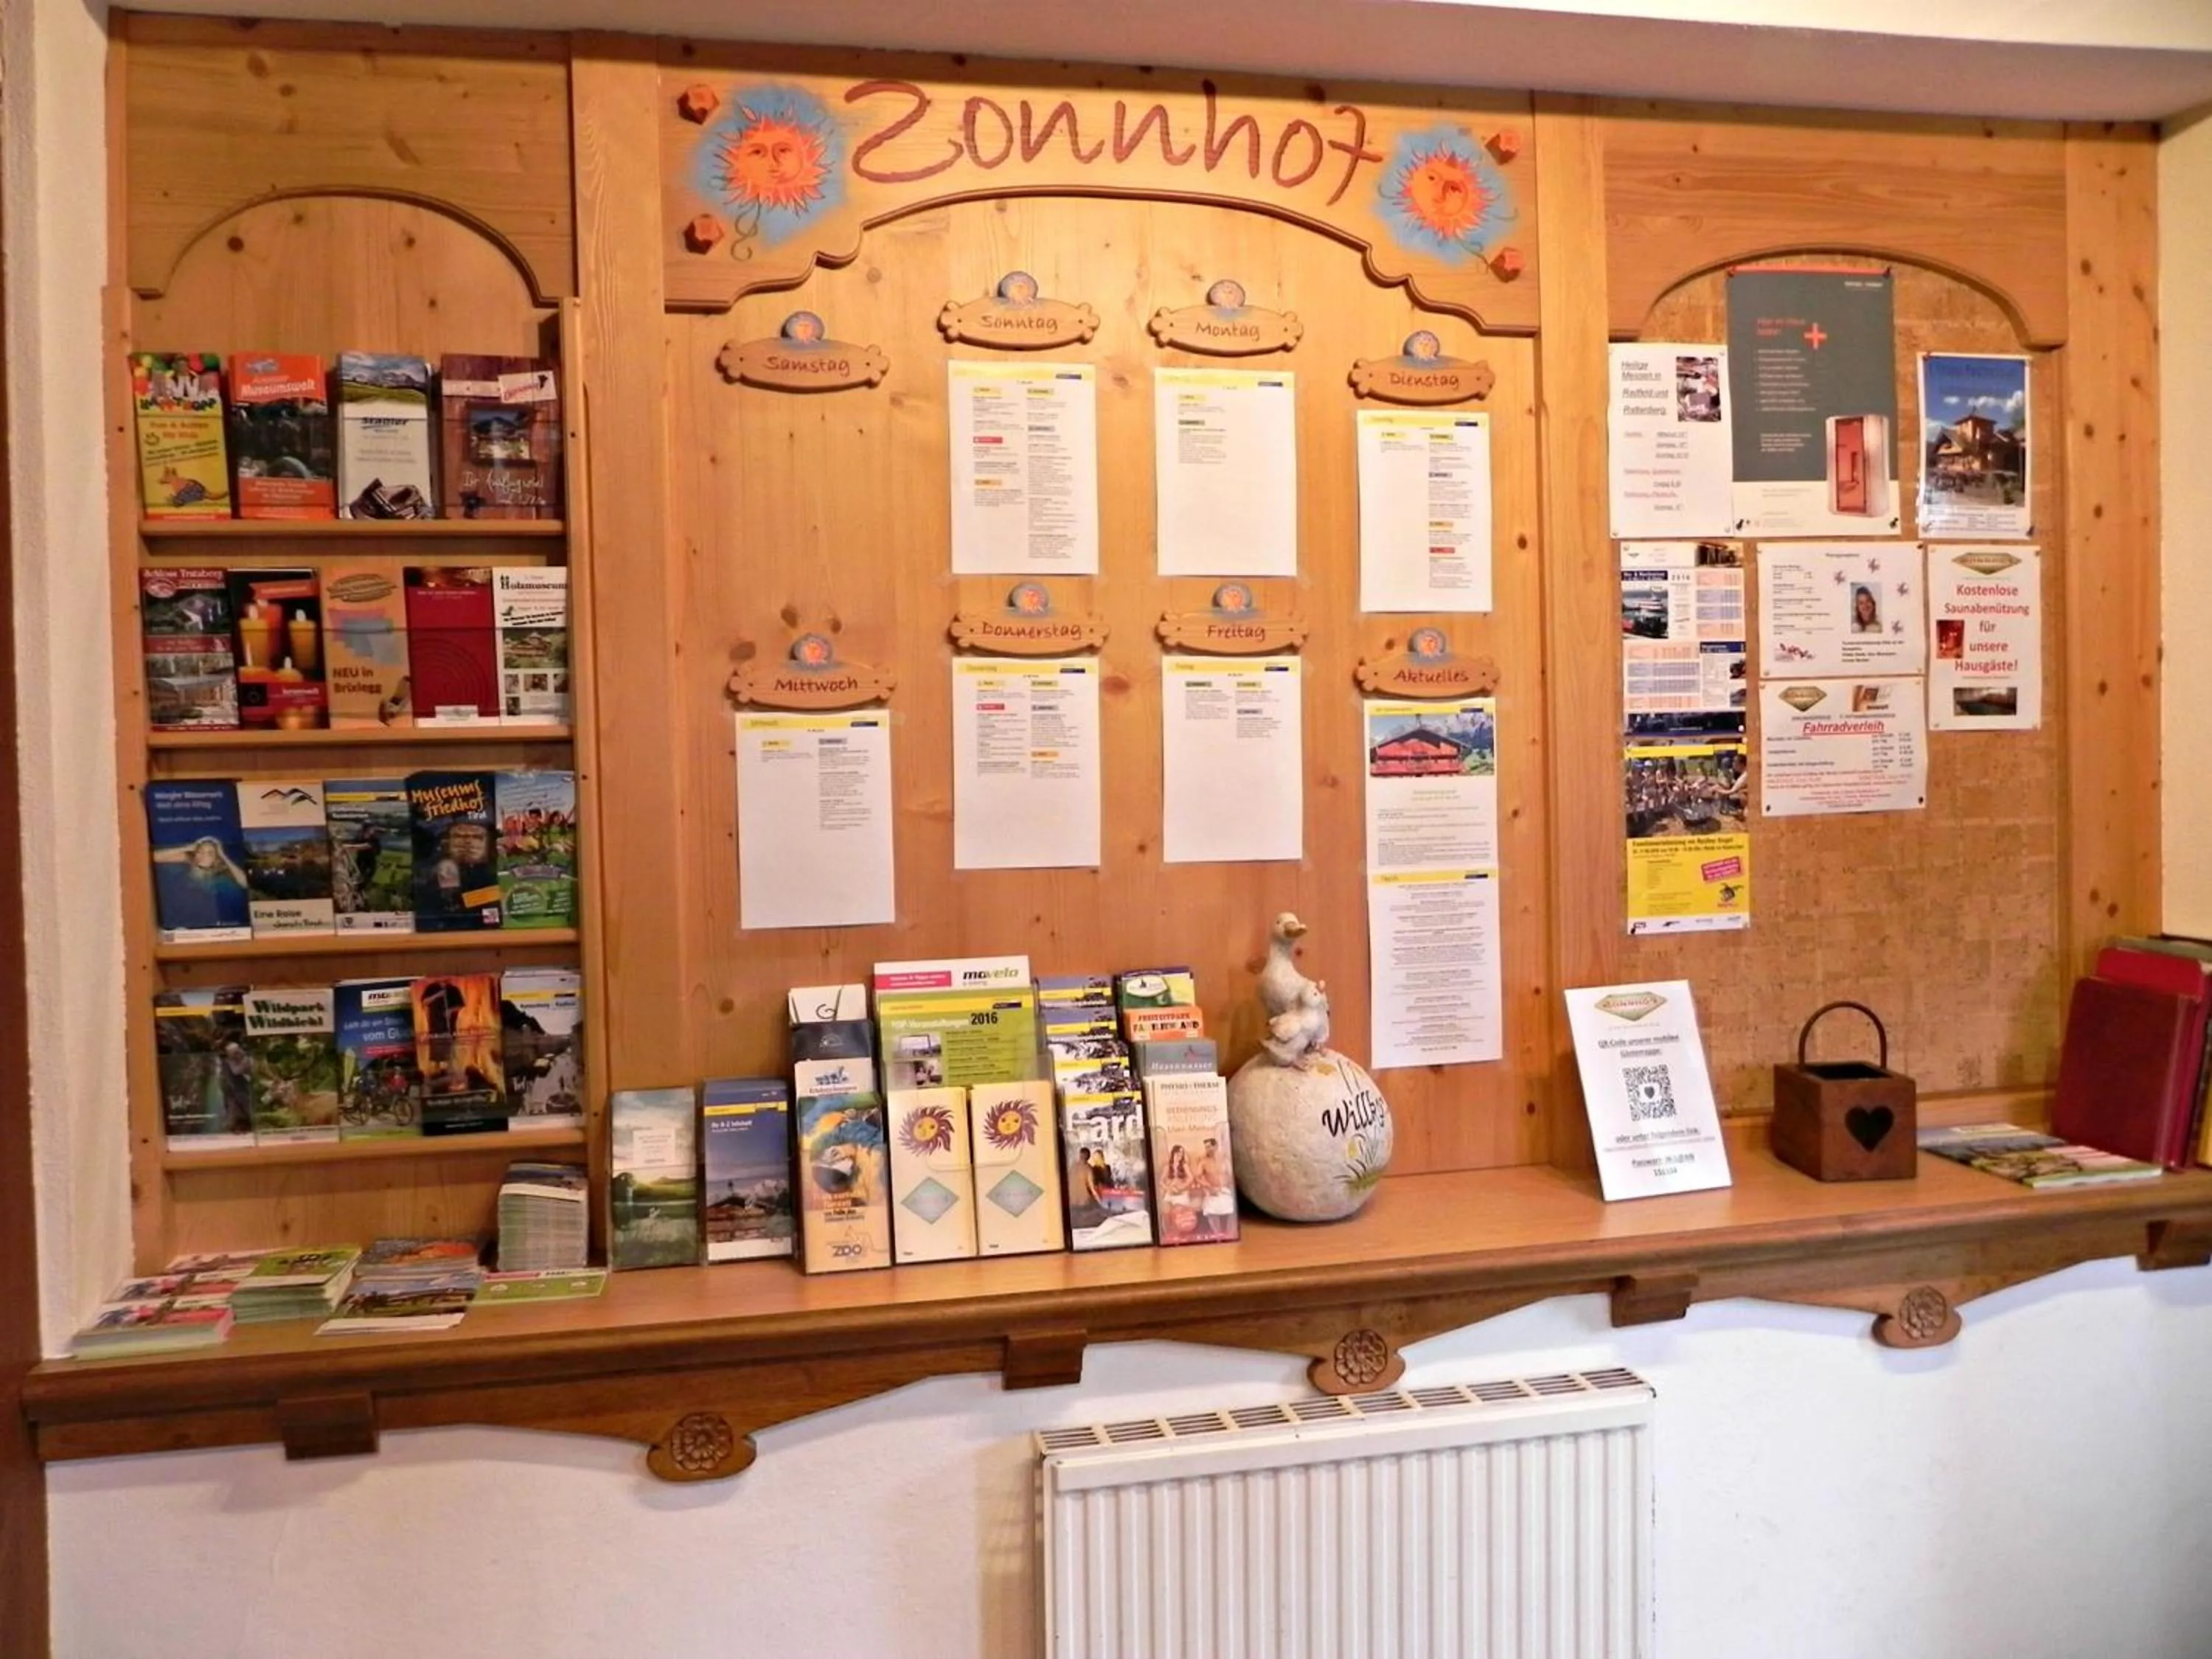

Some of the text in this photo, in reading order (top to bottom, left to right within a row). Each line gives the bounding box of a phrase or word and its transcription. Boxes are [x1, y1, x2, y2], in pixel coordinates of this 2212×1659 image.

[845, 80, 1383, 206] Sonnhof
[981, 315, 1058, 334] Sonntag
[1196, 321, 1260, 341] Montag
[765, 355, 850, 378] Samstag
[1389, 372, 1459, 389] Dienstag
[1956, 585, 2018, 597] Kostenlose
[1945, 603, 2029, 616] Saunabenützung
[981, 622, 1081, 640] Donnerstag
[1207, 625, 1265, 642] Freitag
[1980, 621, 1996, 633] für
[1969, 642, 2008, 652] unsere
[333, 668, 373, 678] NEU in
[1955, 660, 2018, 673] Hausgäste!
[1394, 669, 1469, 684] Aktuelles
[334, 681, 382, 695] Brixlegg
[774, 677, 858, 692] Mittwoch
[1803, 721, 1884, 734] Fahrradverleih
[411, 779, 483, 804] Museums
[425, 795, 484, 821] friedhof
[963, 967, 1019, 980] movelo
[252, 999, 325, 1014] Wildpark
[971, 1012, 998, 1026] 2016
[833, 1243, 862, 1257] ZOO
